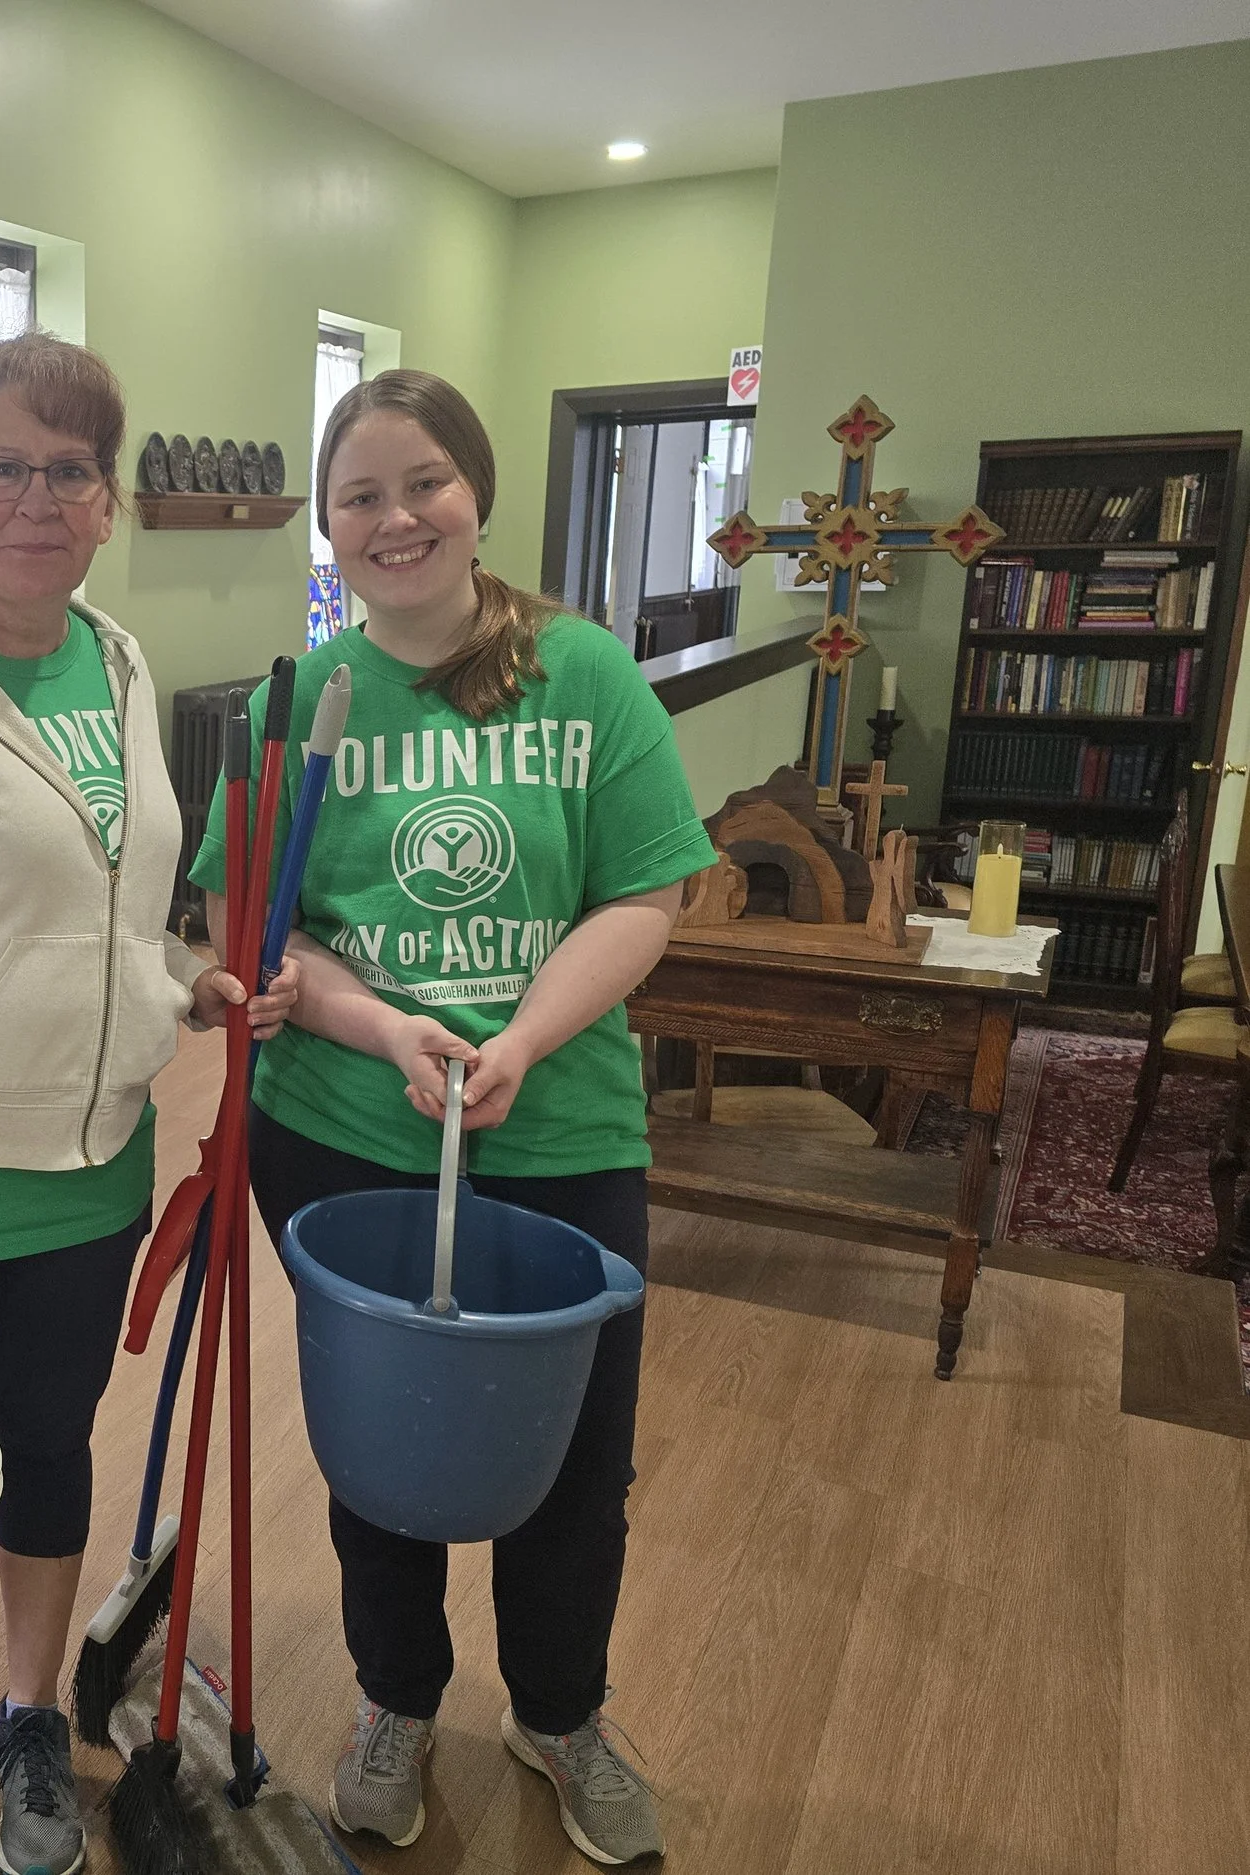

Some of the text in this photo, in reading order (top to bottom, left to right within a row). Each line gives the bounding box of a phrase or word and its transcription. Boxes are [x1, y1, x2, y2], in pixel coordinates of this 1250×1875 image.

[732, 350, 762, 368] AED
[399, 930, 432, 966] OF
[418, 982, 494, 1001] SUSQUEHANNA
